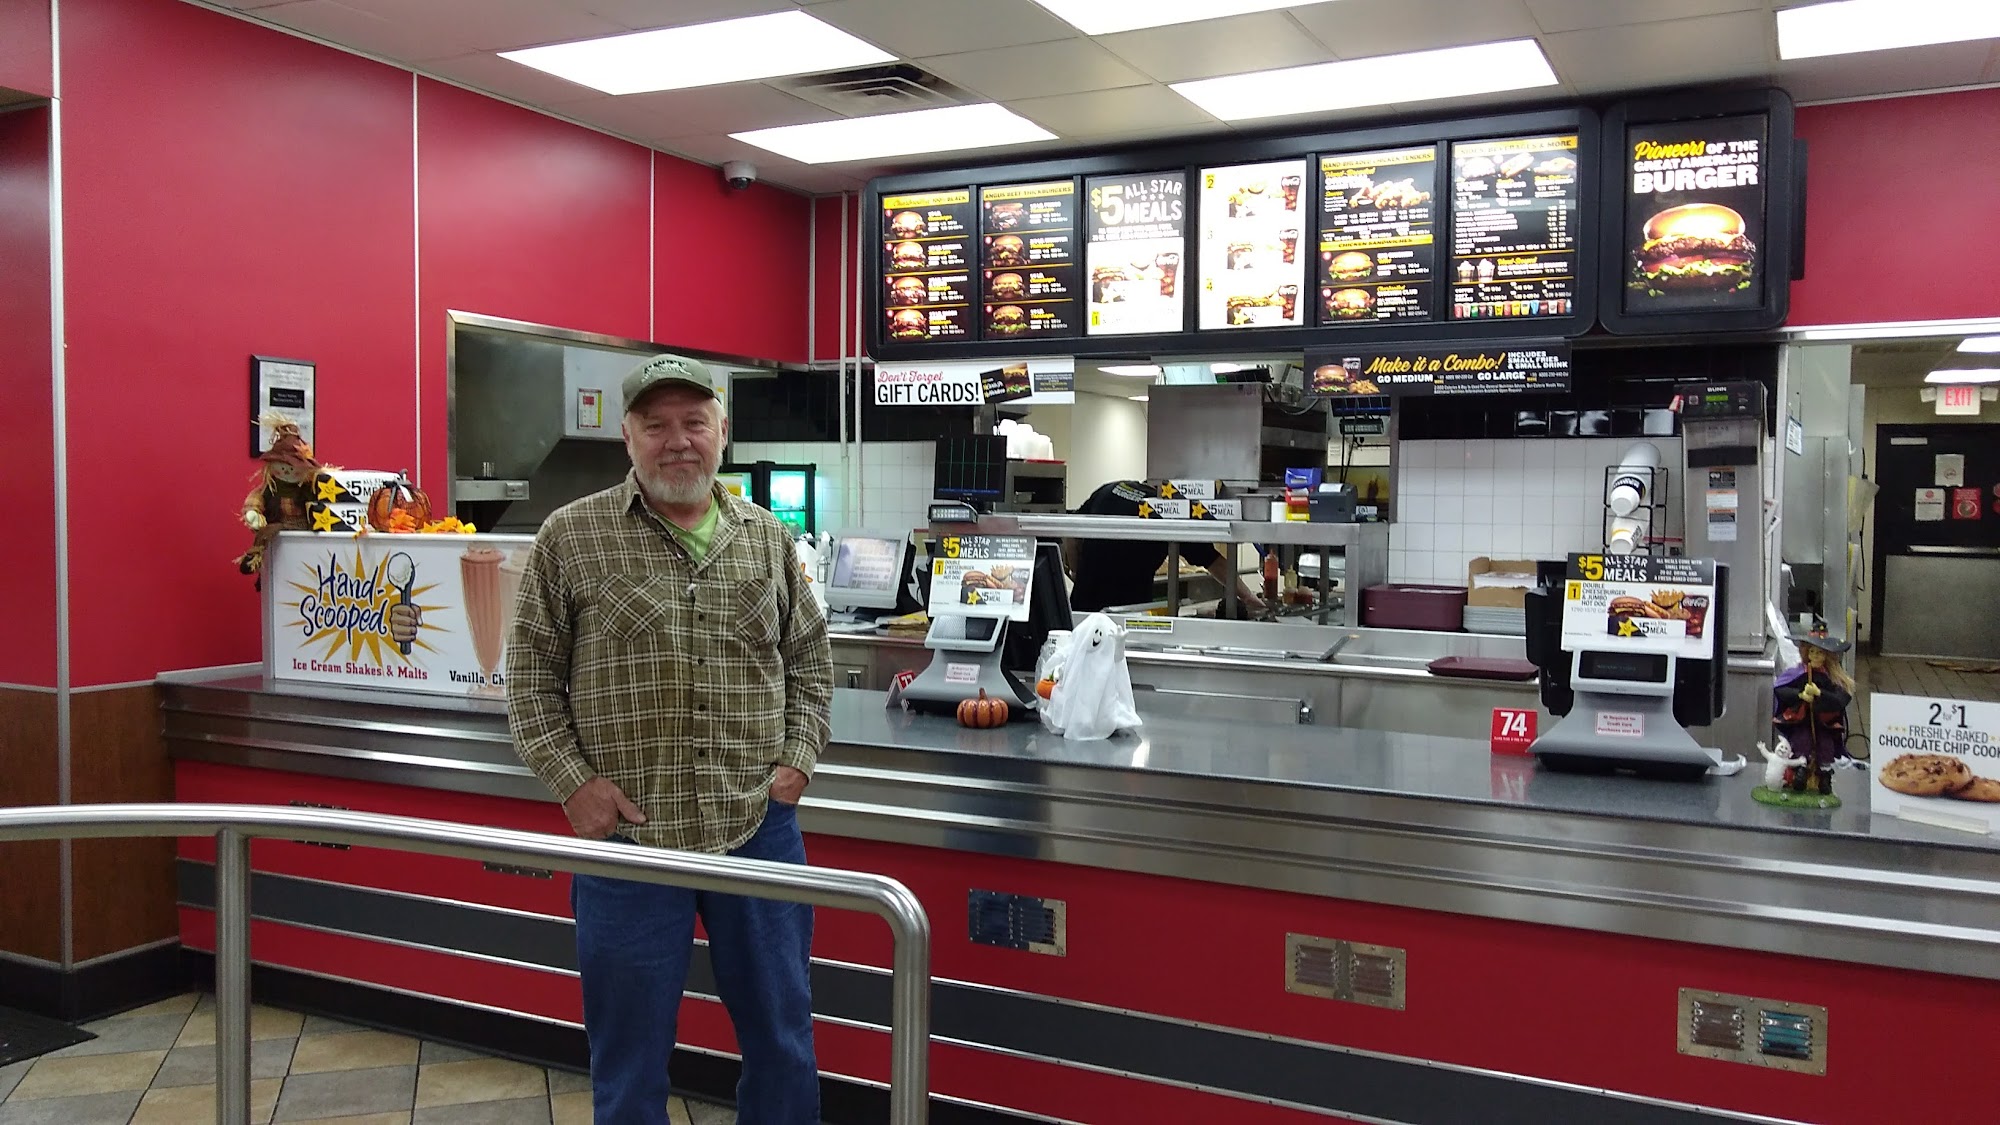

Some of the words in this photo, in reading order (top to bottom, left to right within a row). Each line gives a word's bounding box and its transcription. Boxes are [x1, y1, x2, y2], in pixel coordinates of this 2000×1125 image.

[1547, 140, 1572, 148] MORE
[1635, 140, 1706, 160] Pioneers
[1706, 143, 1726, 155] OF
[1730, 140, 1758, 153] THE
[1634, 159, 1680, 172] GREAT
[1681, 153, 1758, 168] AMERICAN
[1634, 164, 1759, 194] BURGER
[1125, 182, 1148, 200] ALL
[1150, 180, 1182, 196] STAR
[1091, 185, 1125, 226] $5
[1125, 200, 1182, 224] MEALS
[1364, 356, 1411, 375] Make
[1412, 355, 1427, 373] it
[1428, 359, 1442, 372] a
[1443, 352, 1506, 372] Combo!
[1507, 351, 1547, 359] INCLUDES
[1515, 362, 1542, 370] SMALL
[1543, 361, 1568, 369] DRINK
[878, 370, 908, 383] Don't
[909, 371, 944, 385] Forget
[1377, 374, 1392, 384] GO
[1392, 373, 1434, 383] MEDIUM
[1477, 372, 1491, 381] GO
[1492, 371, 1526, 381] LARGE
[878, 384, 914, 403] GIFT
[918, 382, 980, 402] CARDS!
[1945, 388, 1973, 406] EXIT
[346, 480, 362, 496] $5
[1188, 488, 1205, 496] MEAL
[341, 509, 358, 525] $5
[1164, 507, 1180, 515] MEAL
[1217, 508, 1234, 516] MEAL
[943, 537, 960, 559] $5
[961, 537, 972, 546] ALL
[974, 537, 990, 546] STAR
[960, 547, 990, 559] MEALS
[1605, 555, 1623, 566] ALL
[1624, 555, 1648, 568] STAR
[1578, 555, 1603, 581] $5
[1603, 568, 1648, 582] MEALS
[317, 553, 384, 606] Hand-
[1572, 588, 1577, 598] 1
[300, 596, 388, 645] Scooped
[1650, 627, 1669, 635] MEAL
[292, 658, 309, 671] Ice
[311, 659, 344, 674] Cream
[345, 661, 382, 677] Shakes
[386, 666, 394, 676] &
[397, 666, 428, 681] Malts
[449, 669, 488, 686] Vanilla,
[1500, 711, 1528, 737] 74
[1928, 703, 1942, 727] 2
[1943, 712, 1953, 722] for
[1952, 704, 1969, 729] $1
[1909, 726, 1989, 744] FRESHLY-BAKED
[1879, 735, 1941, 752] CHOCOLATE
[1943, 741, 1970, 755] CHIP
